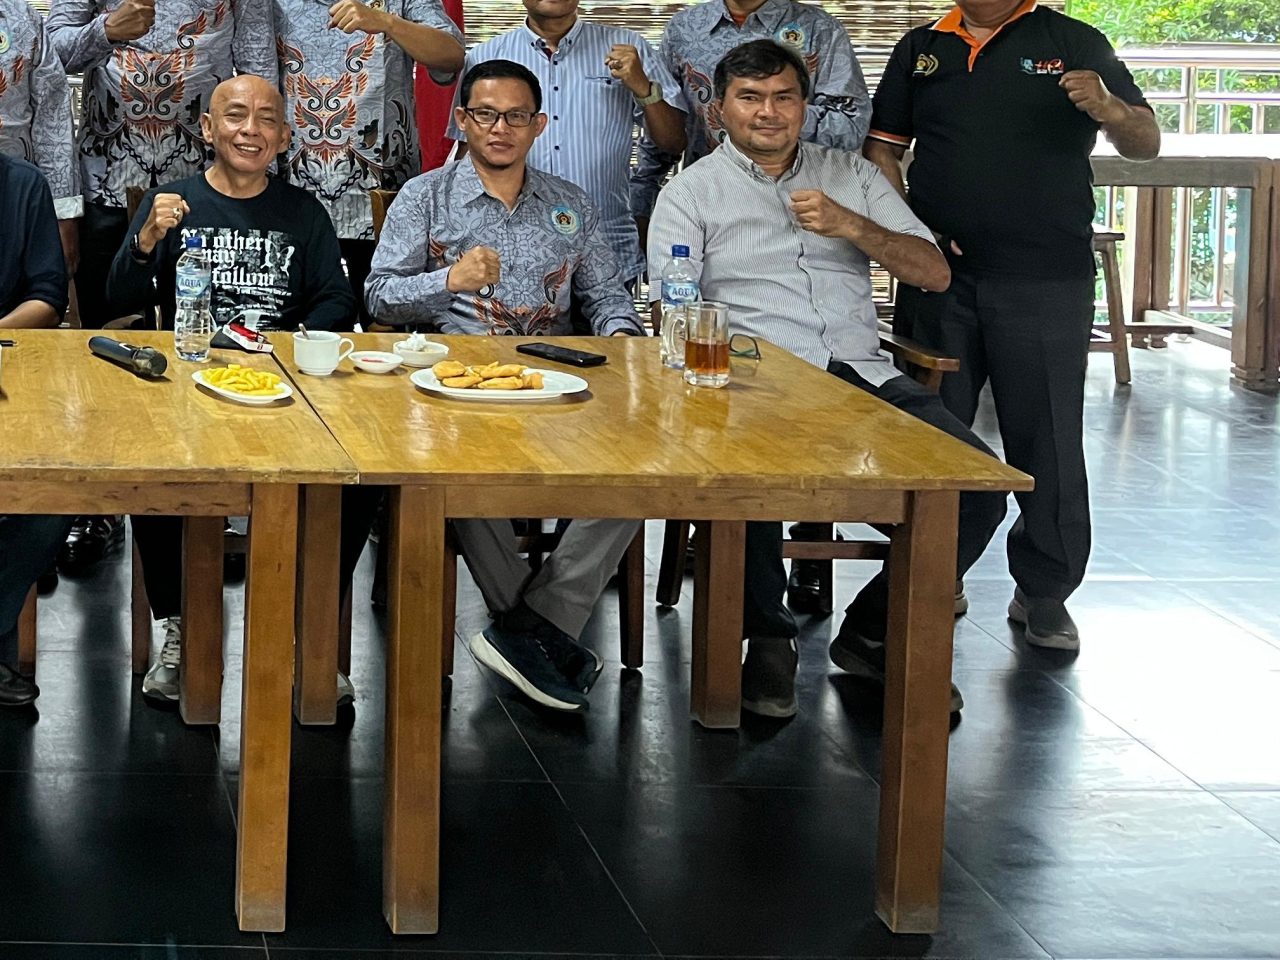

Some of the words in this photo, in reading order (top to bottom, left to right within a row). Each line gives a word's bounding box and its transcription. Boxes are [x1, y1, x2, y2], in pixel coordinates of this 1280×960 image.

[213, 228, 264, 254] other
[180, 278, 202, 288] AQUA
[671, 287, 695, 297] AQUA
